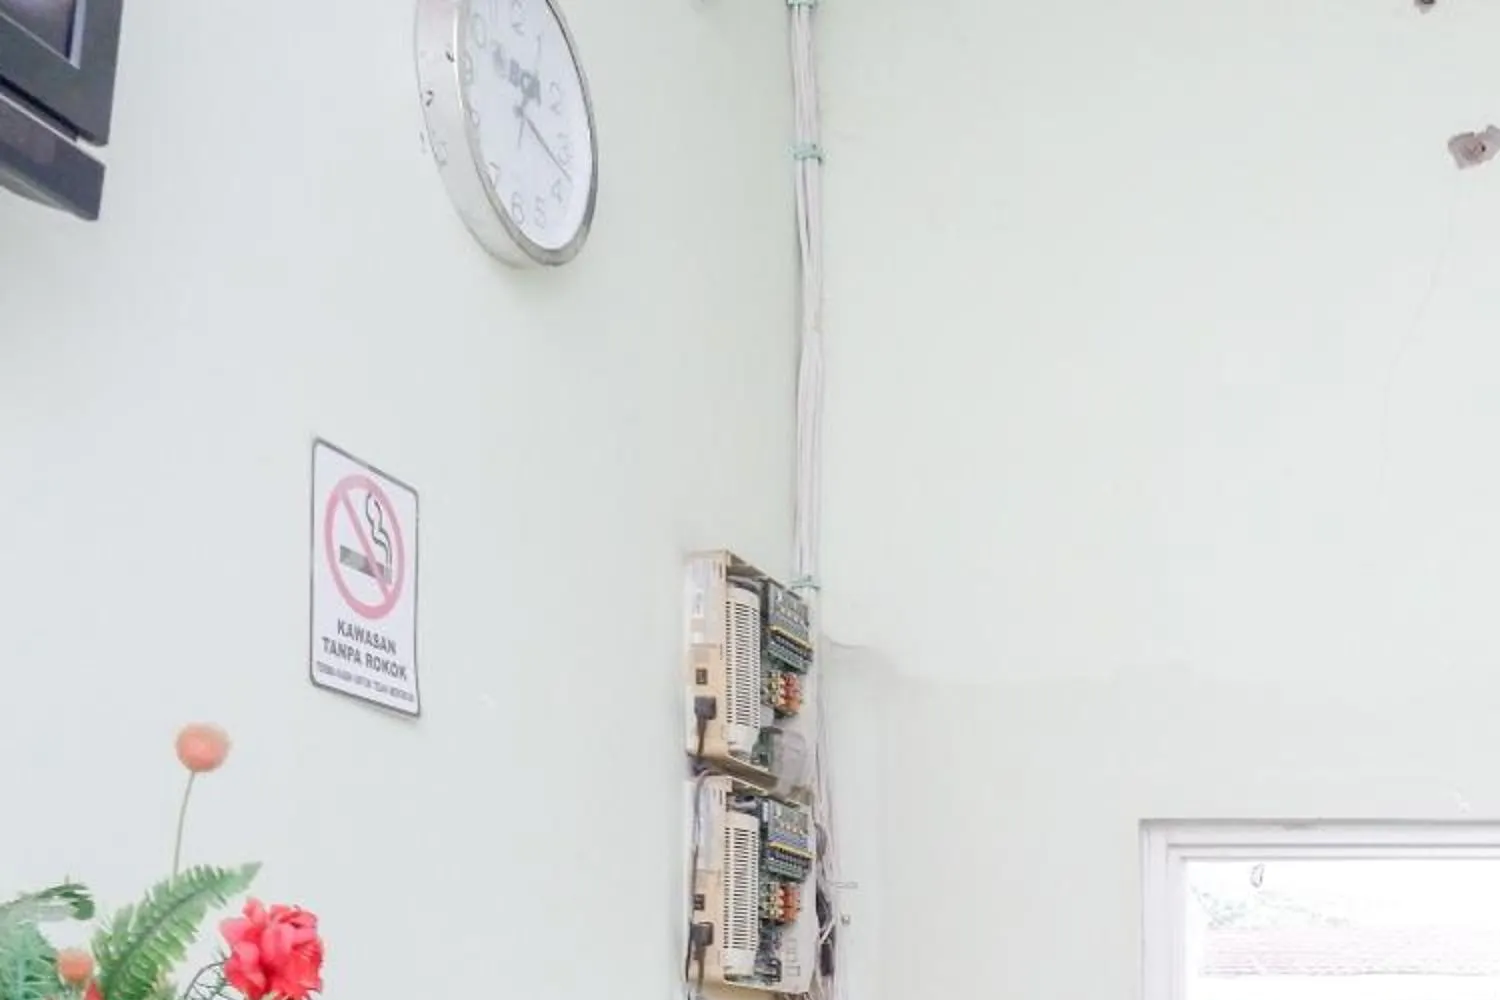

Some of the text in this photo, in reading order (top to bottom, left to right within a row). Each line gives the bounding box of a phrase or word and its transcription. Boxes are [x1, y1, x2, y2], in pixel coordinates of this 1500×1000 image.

[321, 635, 362, 665] TANPA
[365, 651, 407, 681] ROKOK
[337, 618, 397, 656] KAWASAN
